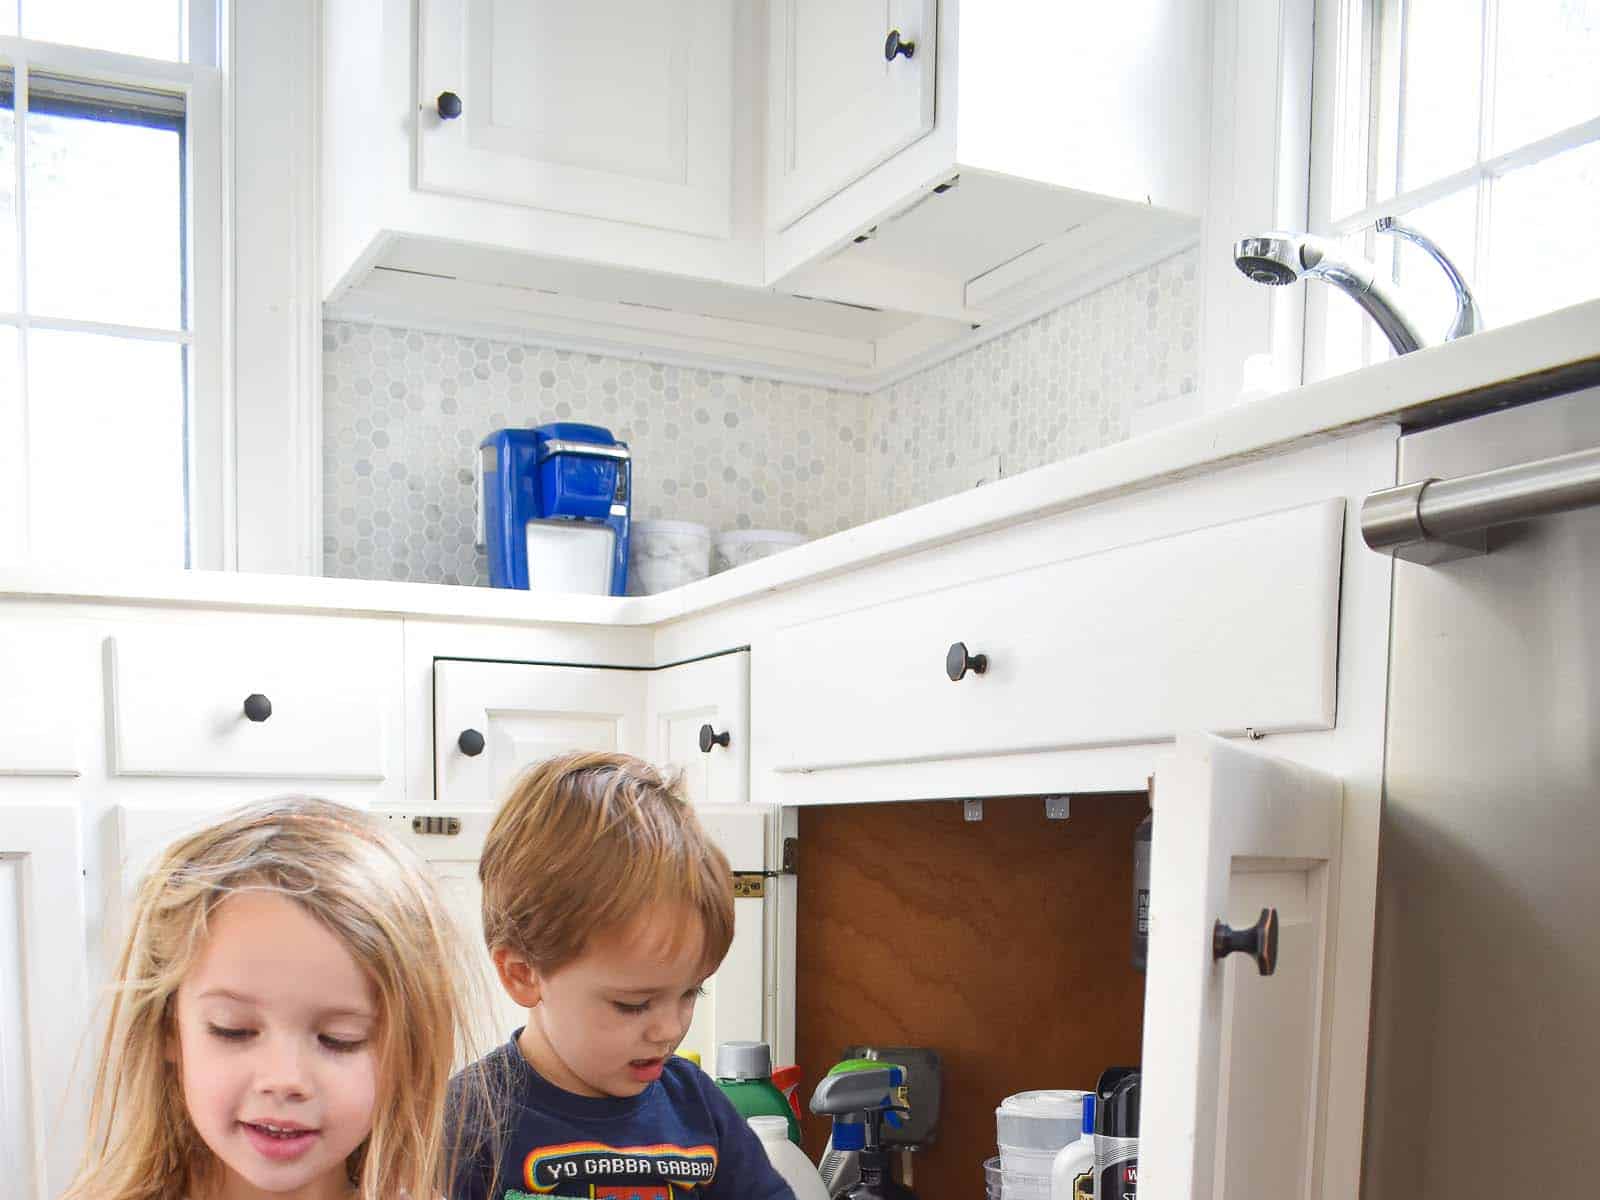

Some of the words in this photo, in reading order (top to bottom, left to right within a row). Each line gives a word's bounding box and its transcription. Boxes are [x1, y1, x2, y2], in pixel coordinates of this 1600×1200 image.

[548, 1161, 578, 1179] YO
[585, 1158, 652, 1175] GABBA
[656, 1160, 713, 1178] GABBA!
